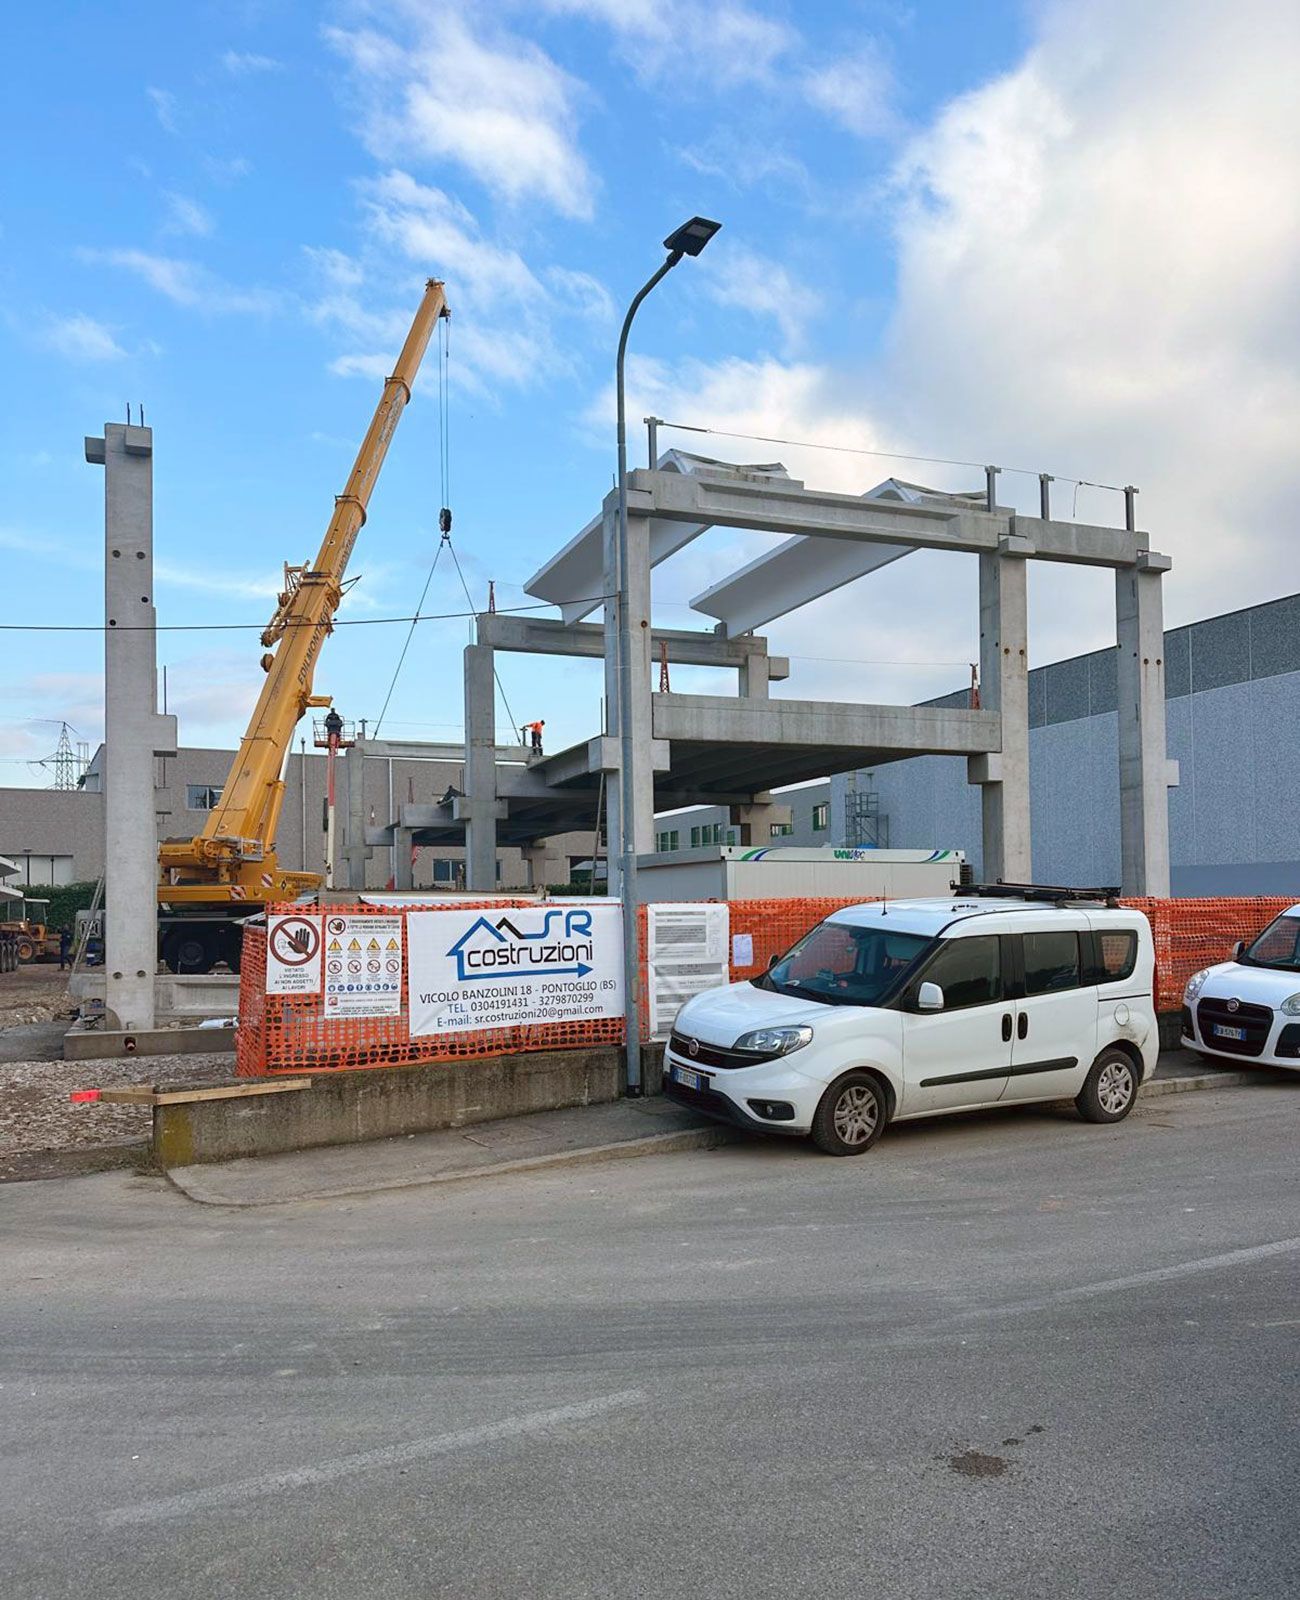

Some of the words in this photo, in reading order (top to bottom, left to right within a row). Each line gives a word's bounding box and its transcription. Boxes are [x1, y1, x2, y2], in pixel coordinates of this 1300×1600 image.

[467, 940, 593, 967] costruzioni
[420, 991, 459, 1004] VICOLO
[462, 986, 518, 1000] BANZOLINI
[521, 985, 532, 995] 18
[542, 981, 597, 993] PONTOGLIO
[599, 980, 617, 991] (BS)
[448, 1003, 468, 1013] TEL.
[470, 997, 528, 1012] 0304191431
[539, 993, 594, 1006] 3279870299
[437, 1014, 472, 1027] E-mail:
[474, 1005, 604, 1024] sr.costruzioni20@gmail.com
